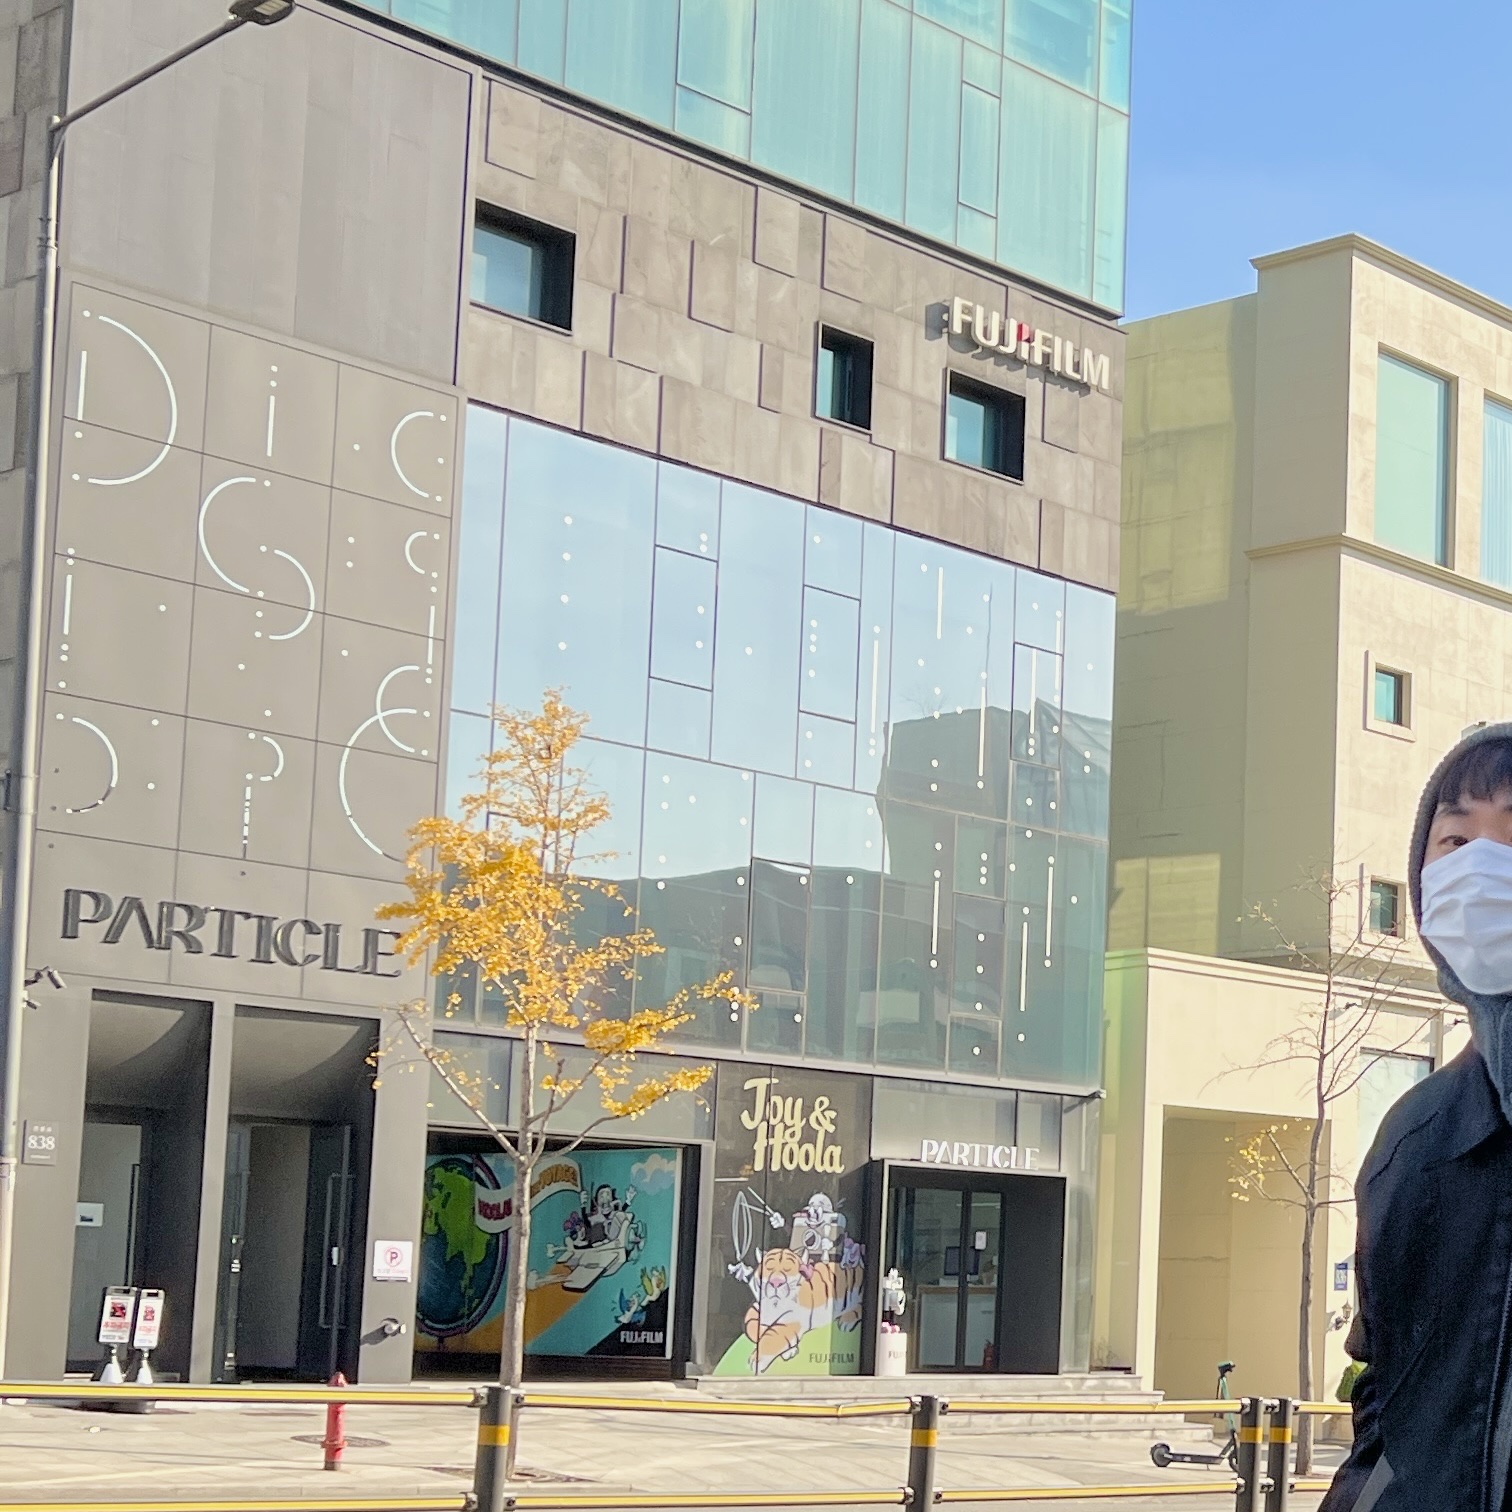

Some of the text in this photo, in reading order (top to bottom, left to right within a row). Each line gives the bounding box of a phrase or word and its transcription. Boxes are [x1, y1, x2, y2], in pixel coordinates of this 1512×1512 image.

[953, 296, 1110, 389] FUJIFILM
[60, 888, 402, 978] PARTICLE
[740, 1077, 837, 1143] Joy &
[28, 1135, 55, 1150] 838
[753, 1121, 845, 1174] Hoola
[920, 1139, 1040, 1171] PARTICLE
[620, 1330, 664, 1344] FUJIFILM
[809, 1353, 855, 1364] FUJIFILM
